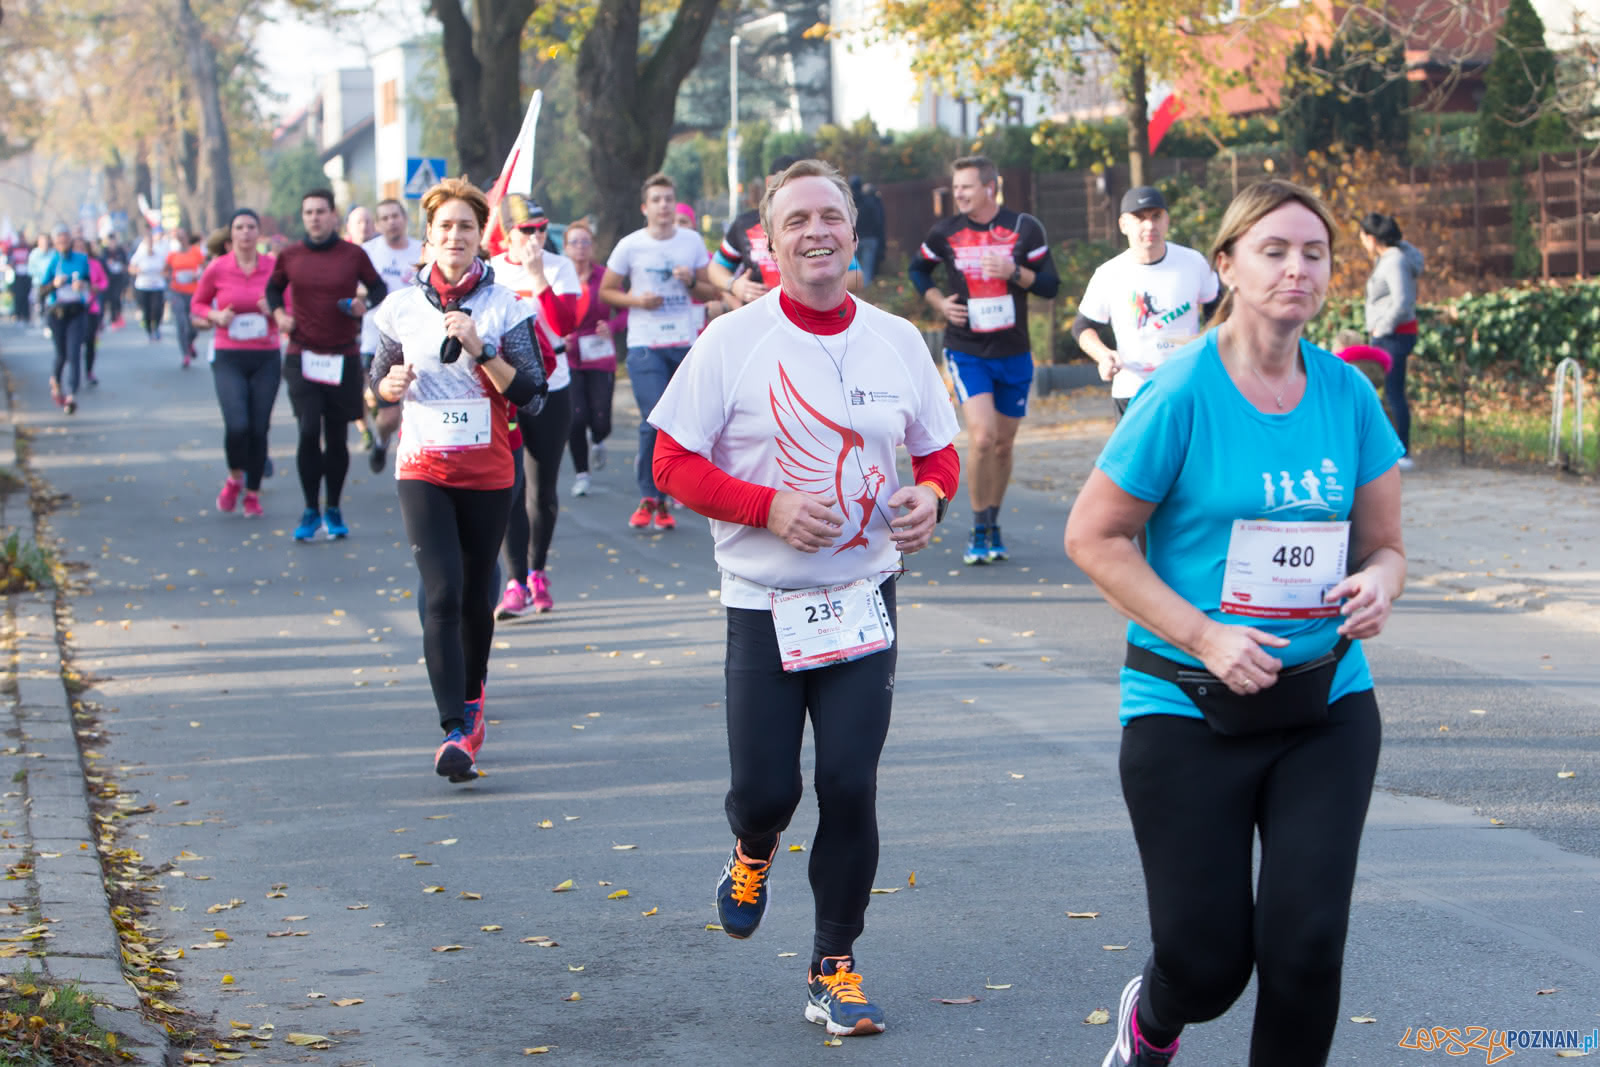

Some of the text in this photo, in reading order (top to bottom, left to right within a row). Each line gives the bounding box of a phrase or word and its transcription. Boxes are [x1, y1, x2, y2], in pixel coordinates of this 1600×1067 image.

[1162, 301, 1191, 324] TEAM
[443, 412, 469, 424] 254
[1272, 545, 1315, 568] 480
[805, 600, 844, 624] 235
